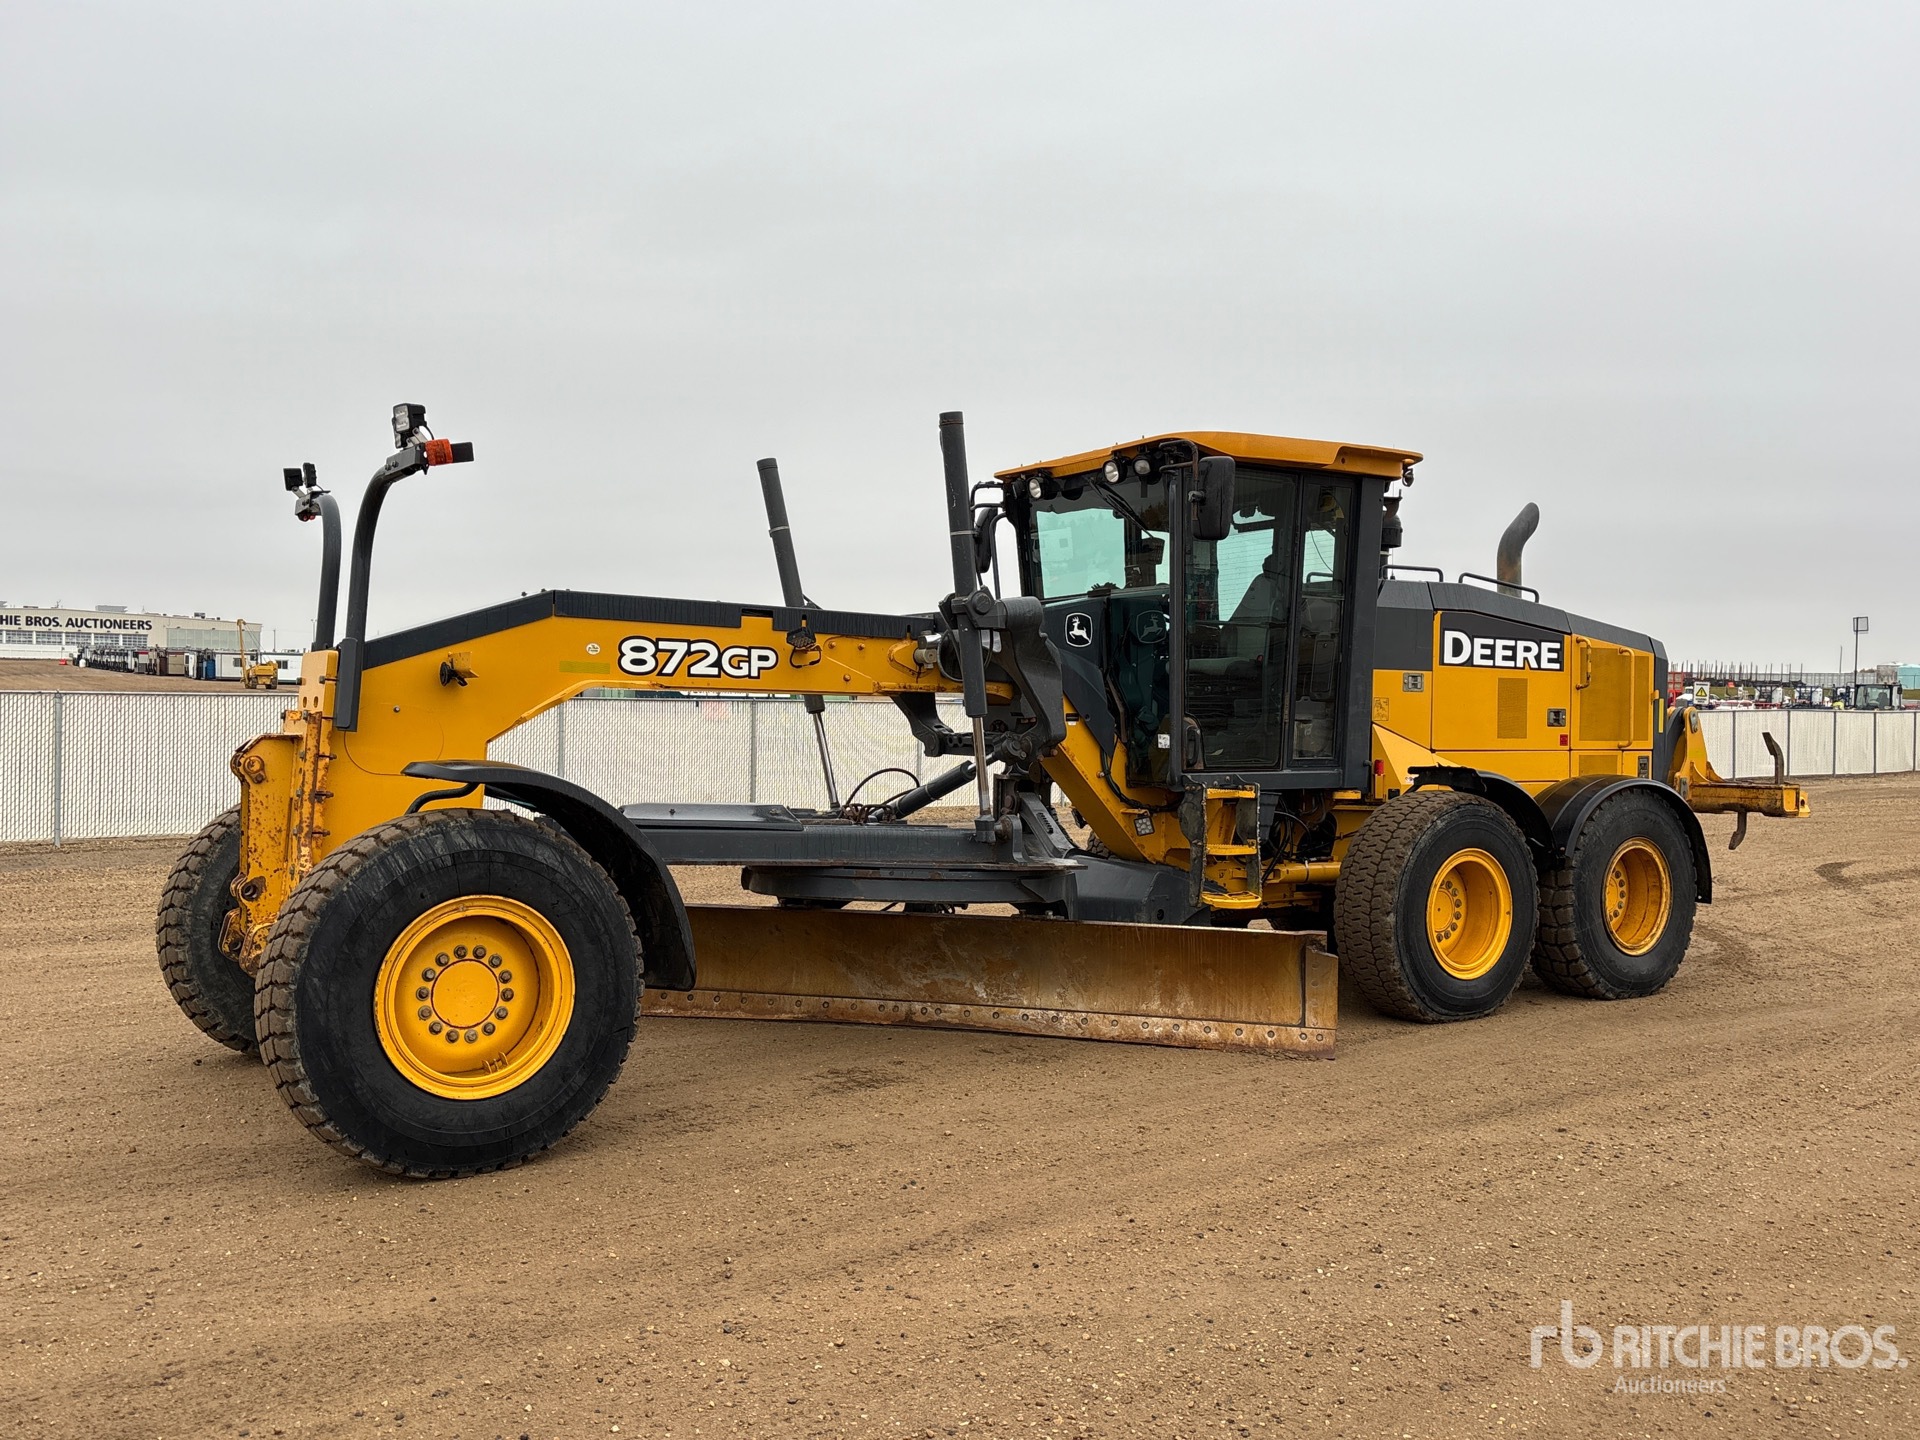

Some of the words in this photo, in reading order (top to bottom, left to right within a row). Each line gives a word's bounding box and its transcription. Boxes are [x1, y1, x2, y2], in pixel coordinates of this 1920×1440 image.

[25, 615, 62, 627] BROS.
[65, 617, 152, 630] AUCTIONEERS
[618, 636, 778, 679] 872GP
[1443, 630, 1561, 670] DEERE
